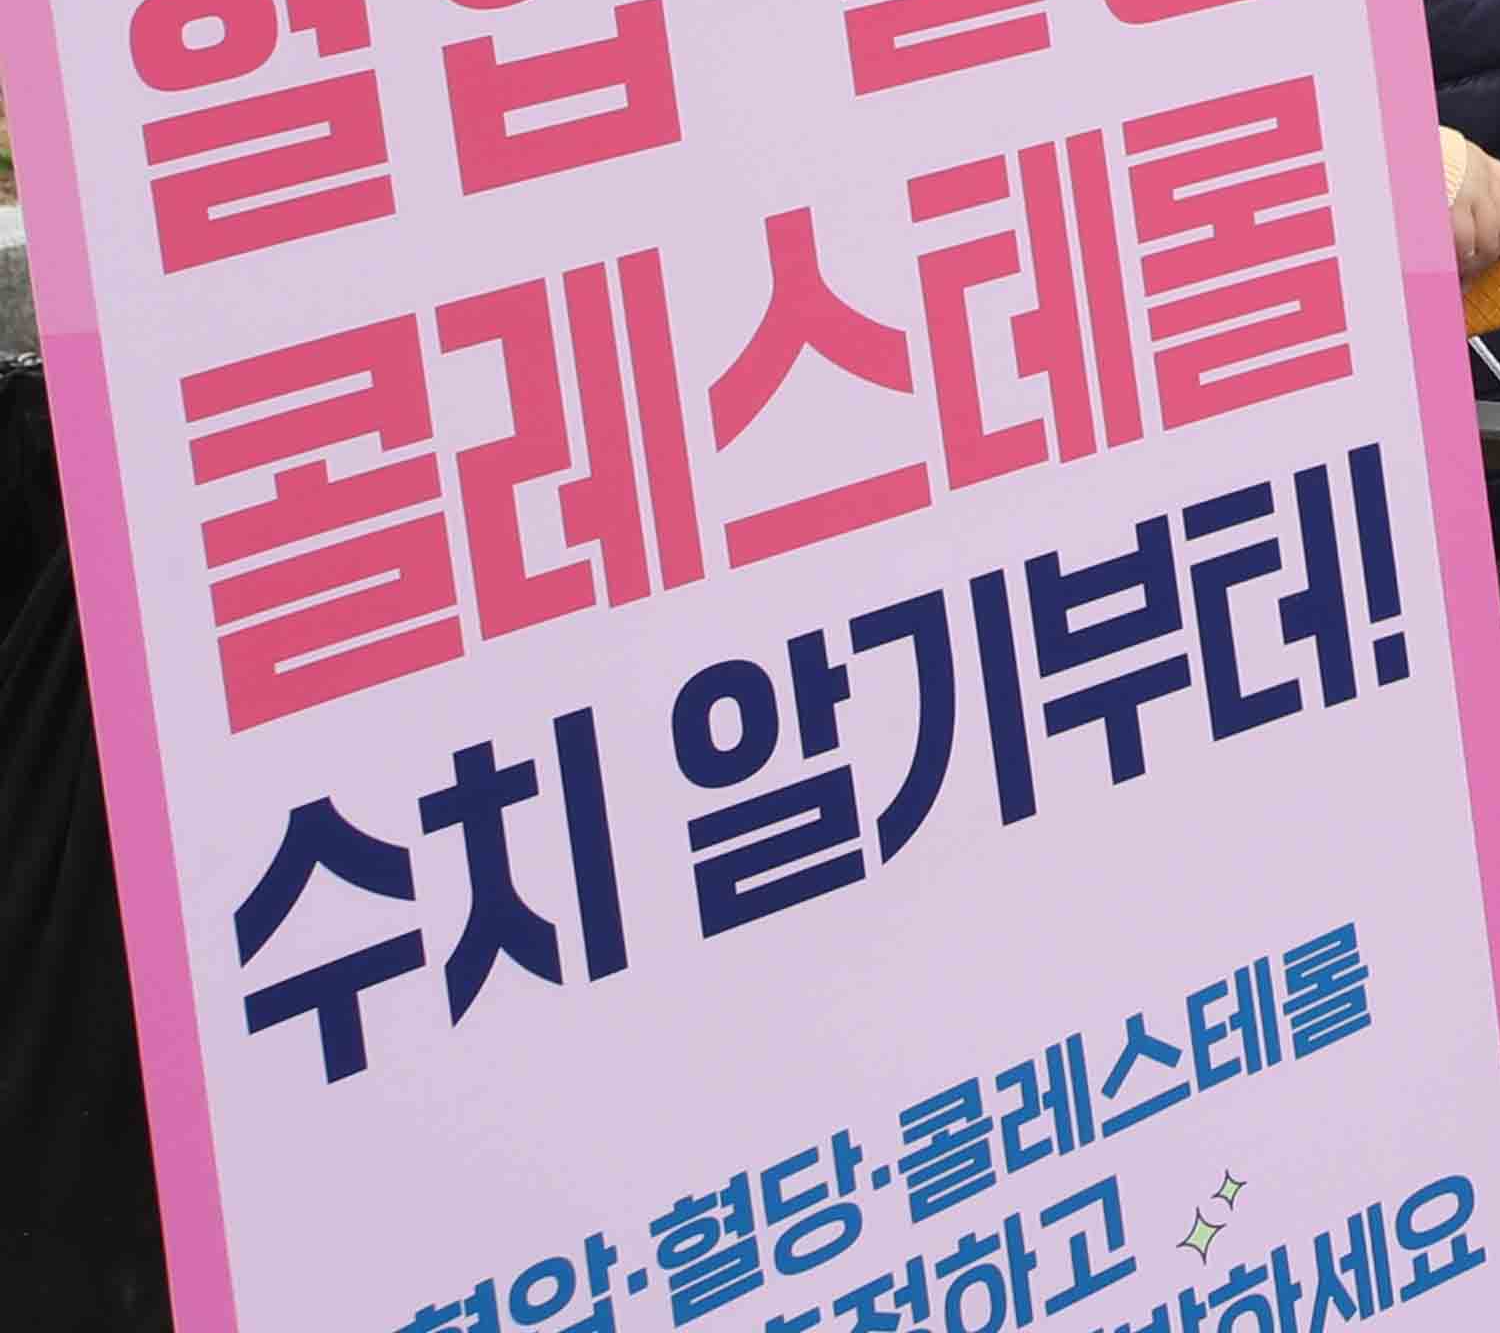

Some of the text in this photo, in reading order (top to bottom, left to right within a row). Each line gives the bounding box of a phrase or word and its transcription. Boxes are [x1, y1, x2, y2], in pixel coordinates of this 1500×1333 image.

[179, 74, 1355, 737] 콜레스테롤
[233, 442, 1411, 1084] 수치 알기부터!
[764, 1175, 1137, 1333] 정하고
